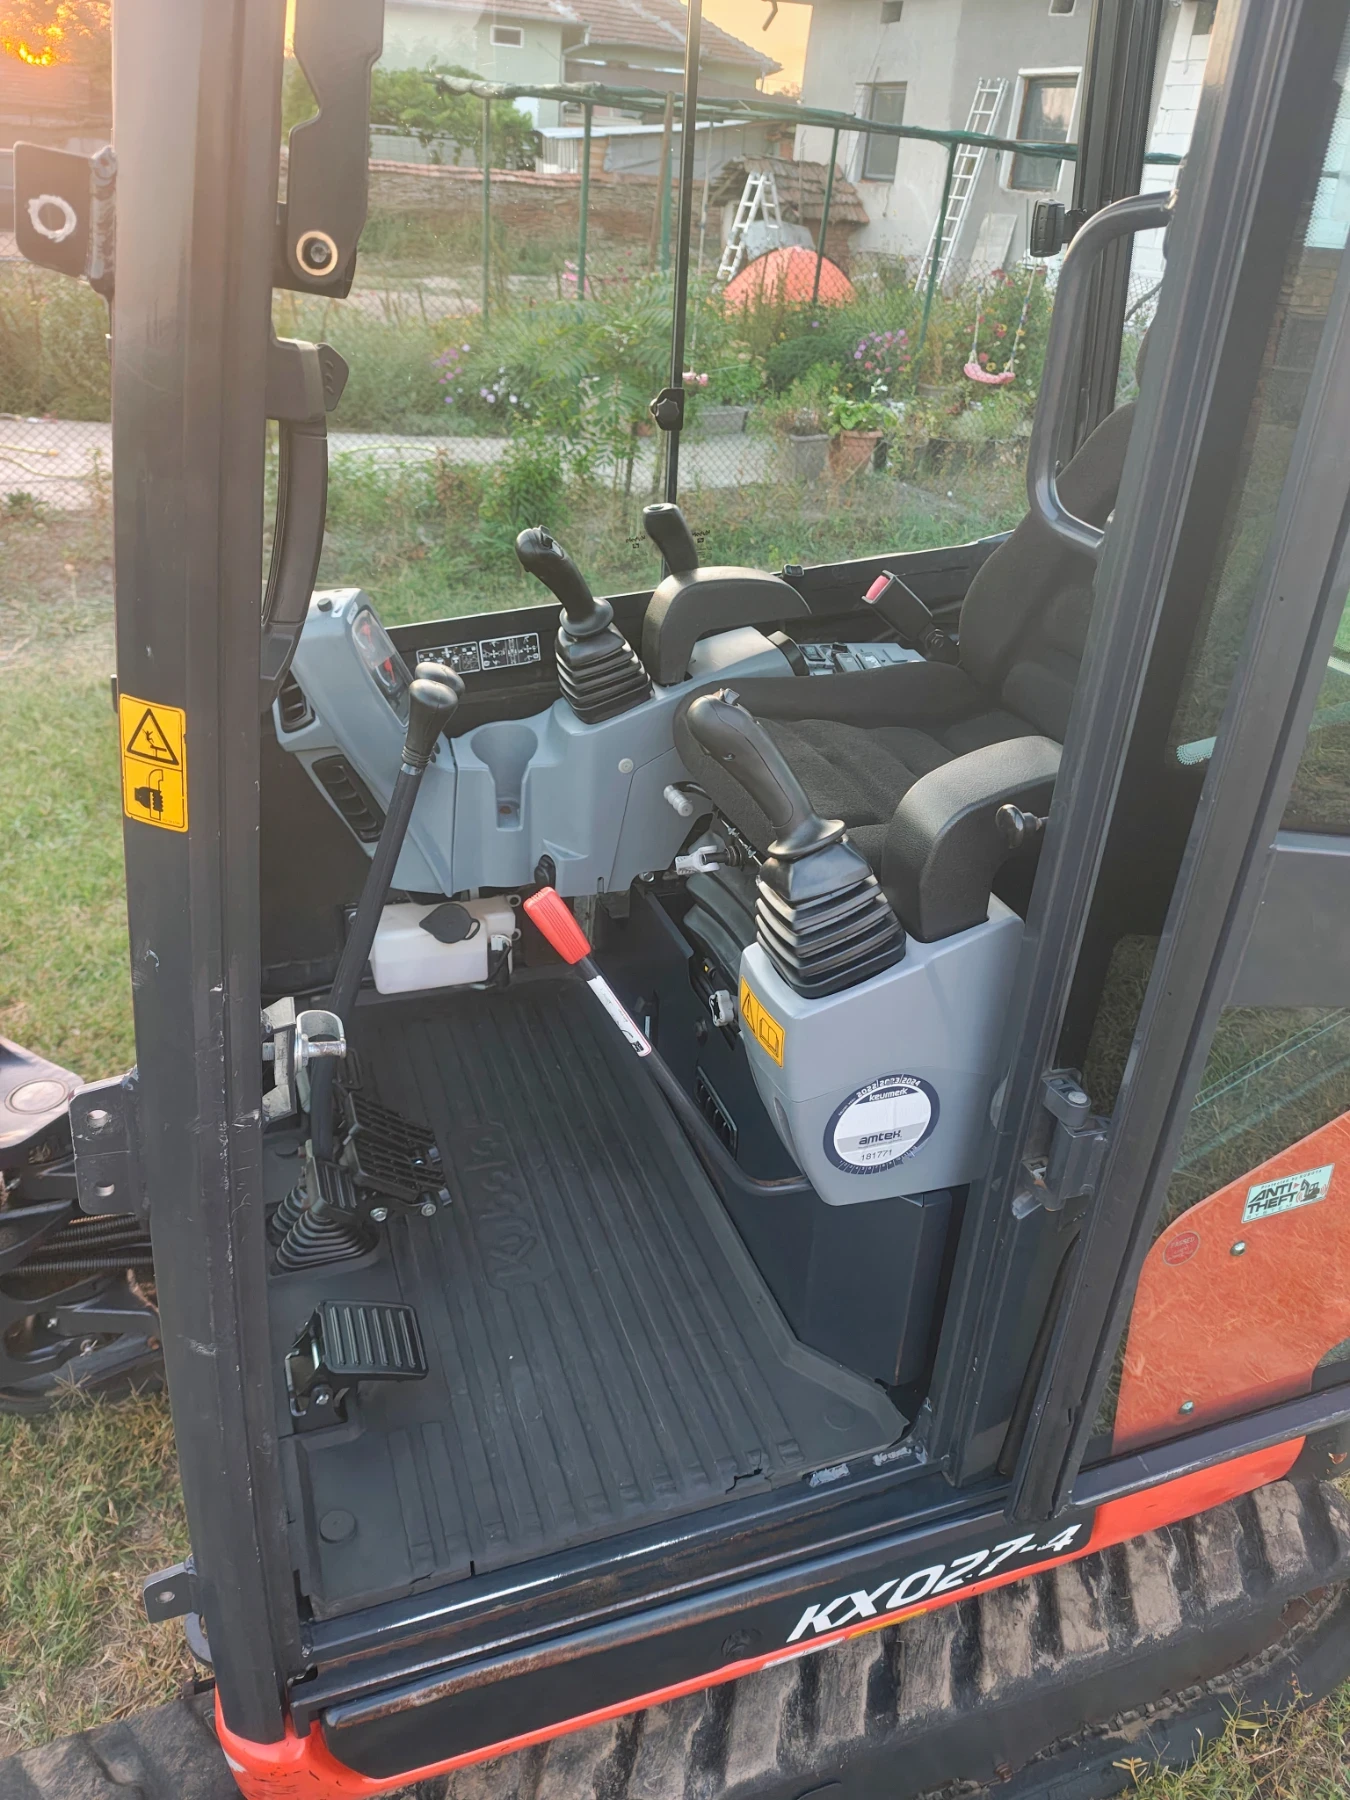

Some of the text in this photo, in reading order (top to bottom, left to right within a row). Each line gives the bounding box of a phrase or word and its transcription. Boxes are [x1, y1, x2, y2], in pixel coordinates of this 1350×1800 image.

[856, 1083, 877, 1098] 2022
[901, 1077, 921, 1087] 2024
[858, 1129, 902, 1145] amtek
[861, 1149, 892, 1161] 181771
[1247, 1191, 1298, 1214] THEFT
[1249, 1182, 1293, 1203] ANTI
[786, 1523, 1082, 1643] KX027-4
